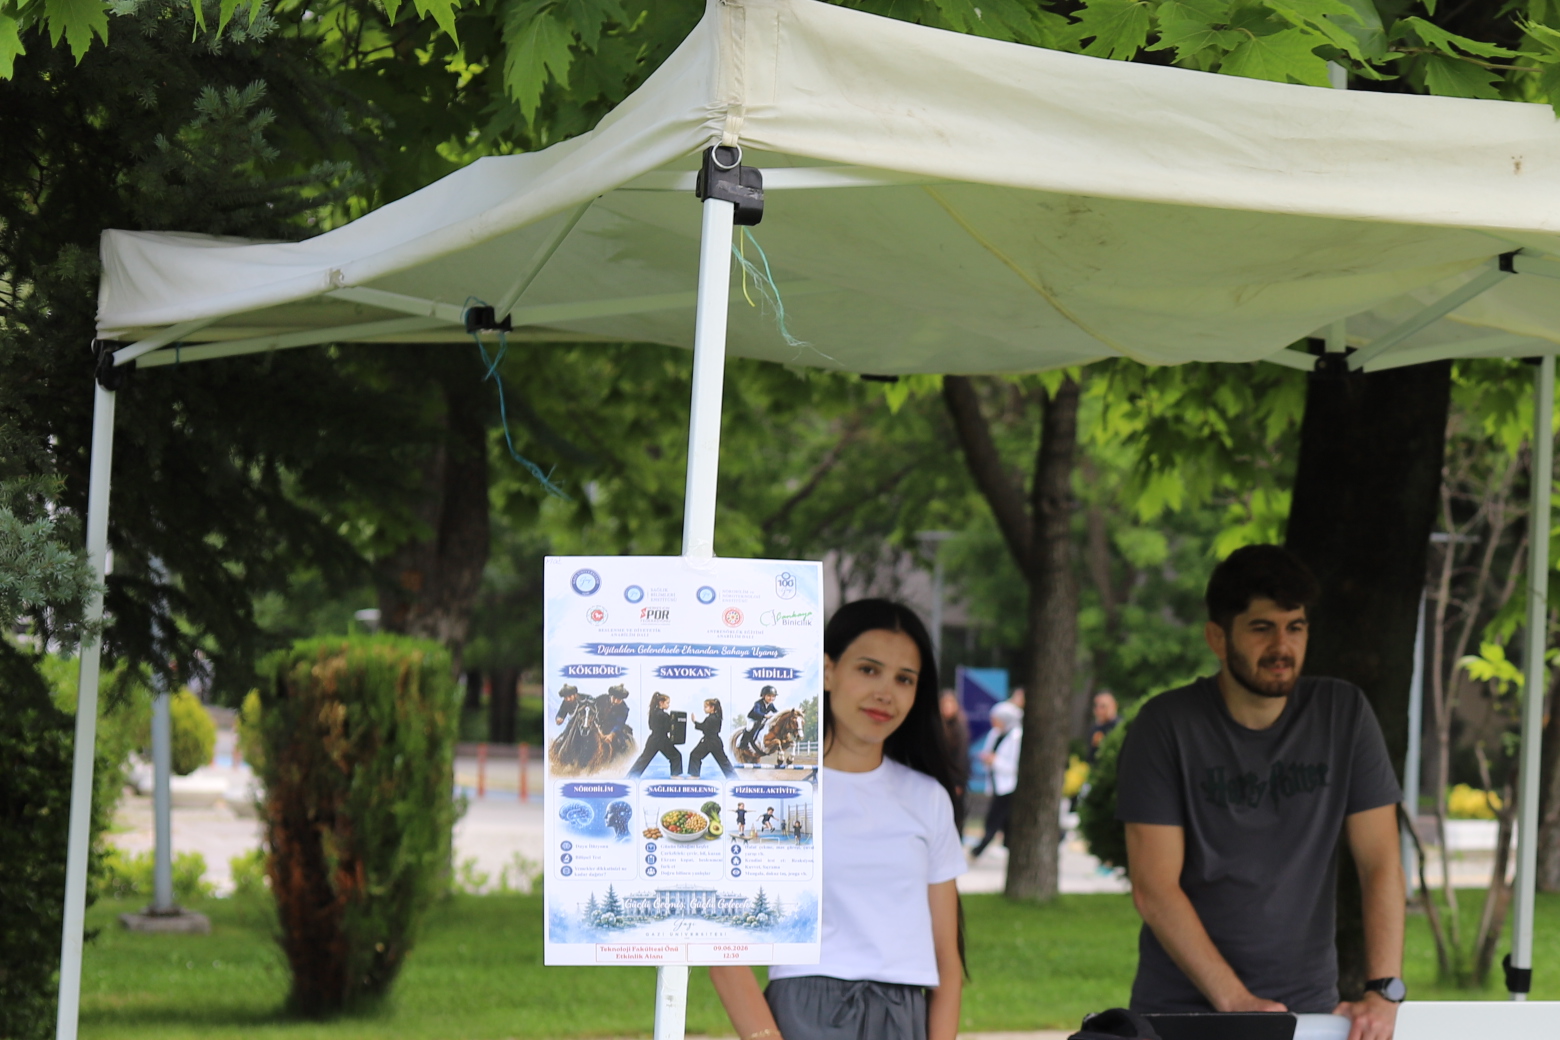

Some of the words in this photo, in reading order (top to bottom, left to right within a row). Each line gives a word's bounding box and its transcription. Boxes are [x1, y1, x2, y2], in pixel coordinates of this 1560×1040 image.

[640, 607, 670, 620] SPOR
[597, 645, 635, 655] Dijitalden
[637, 645, 680, 654] Geleneksele
[681, 645, 719, 655] Ekrandan
[721, 645, 749, 657] Sahaya
[752, 647, 778, 658] Uyanış
[660, 667, 711, 677] SAYOKAN
[752, 667, 794, 679] MİDİLLİ
[573, 785, 614, 793] NÖROBİLİM
[648, 785, 681, 793] SAĞLIKLI
[735, 786, 765, 794] FİZİKSEL
[766, 786, 797, 794] AKTİVİTE
[624, 898, 649, 910] Güçlü
[600, 945, 631, 953] Teknoloji
